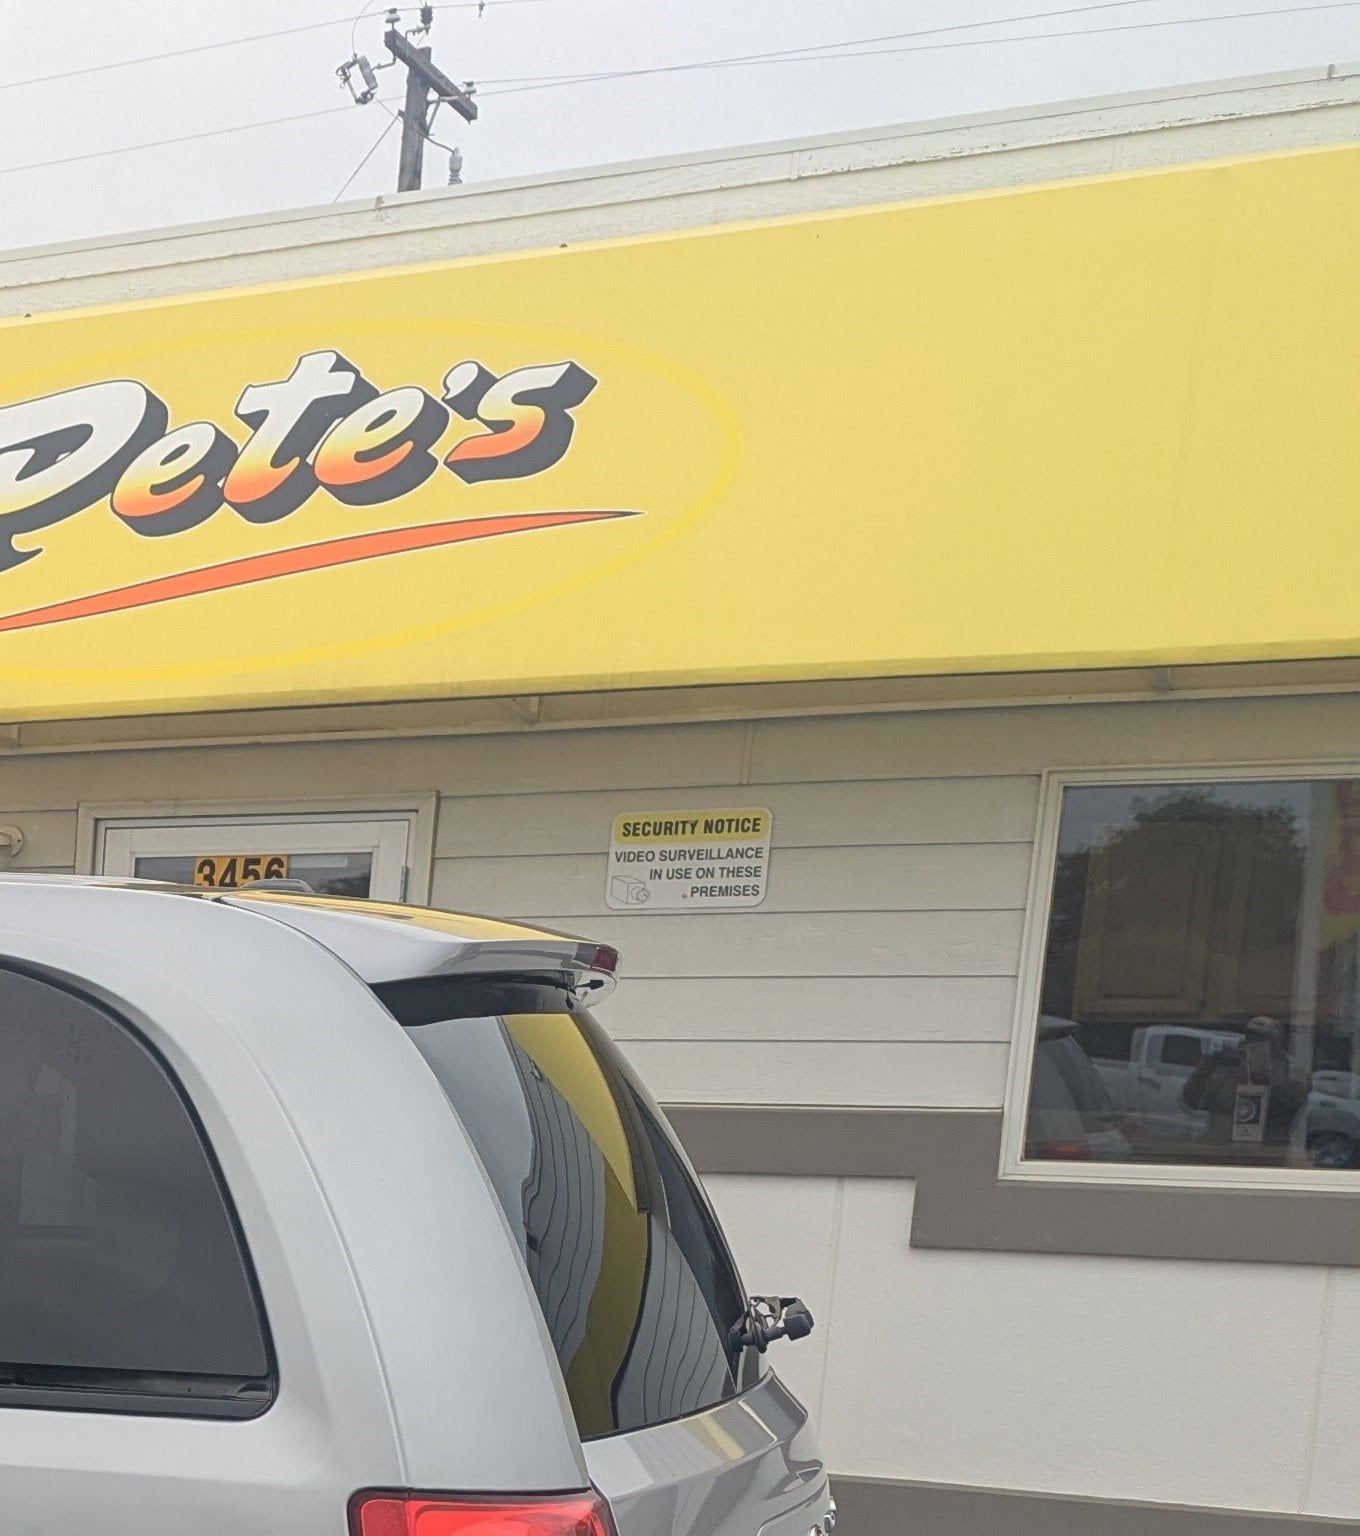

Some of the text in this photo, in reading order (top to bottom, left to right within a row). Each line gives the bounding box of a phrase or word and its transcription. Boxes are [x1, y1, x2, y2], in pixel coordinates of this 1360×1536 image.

[622, 817, 762, 838] SECURITY NOTICE
[614, 847, 764, 863] VIDEO SURVEILLANCE
[195, 856, 285, 888] 3456
[649, 866, 762, 880] IN USE ON THESE
[690, 885, 760, 898] PREMISES
